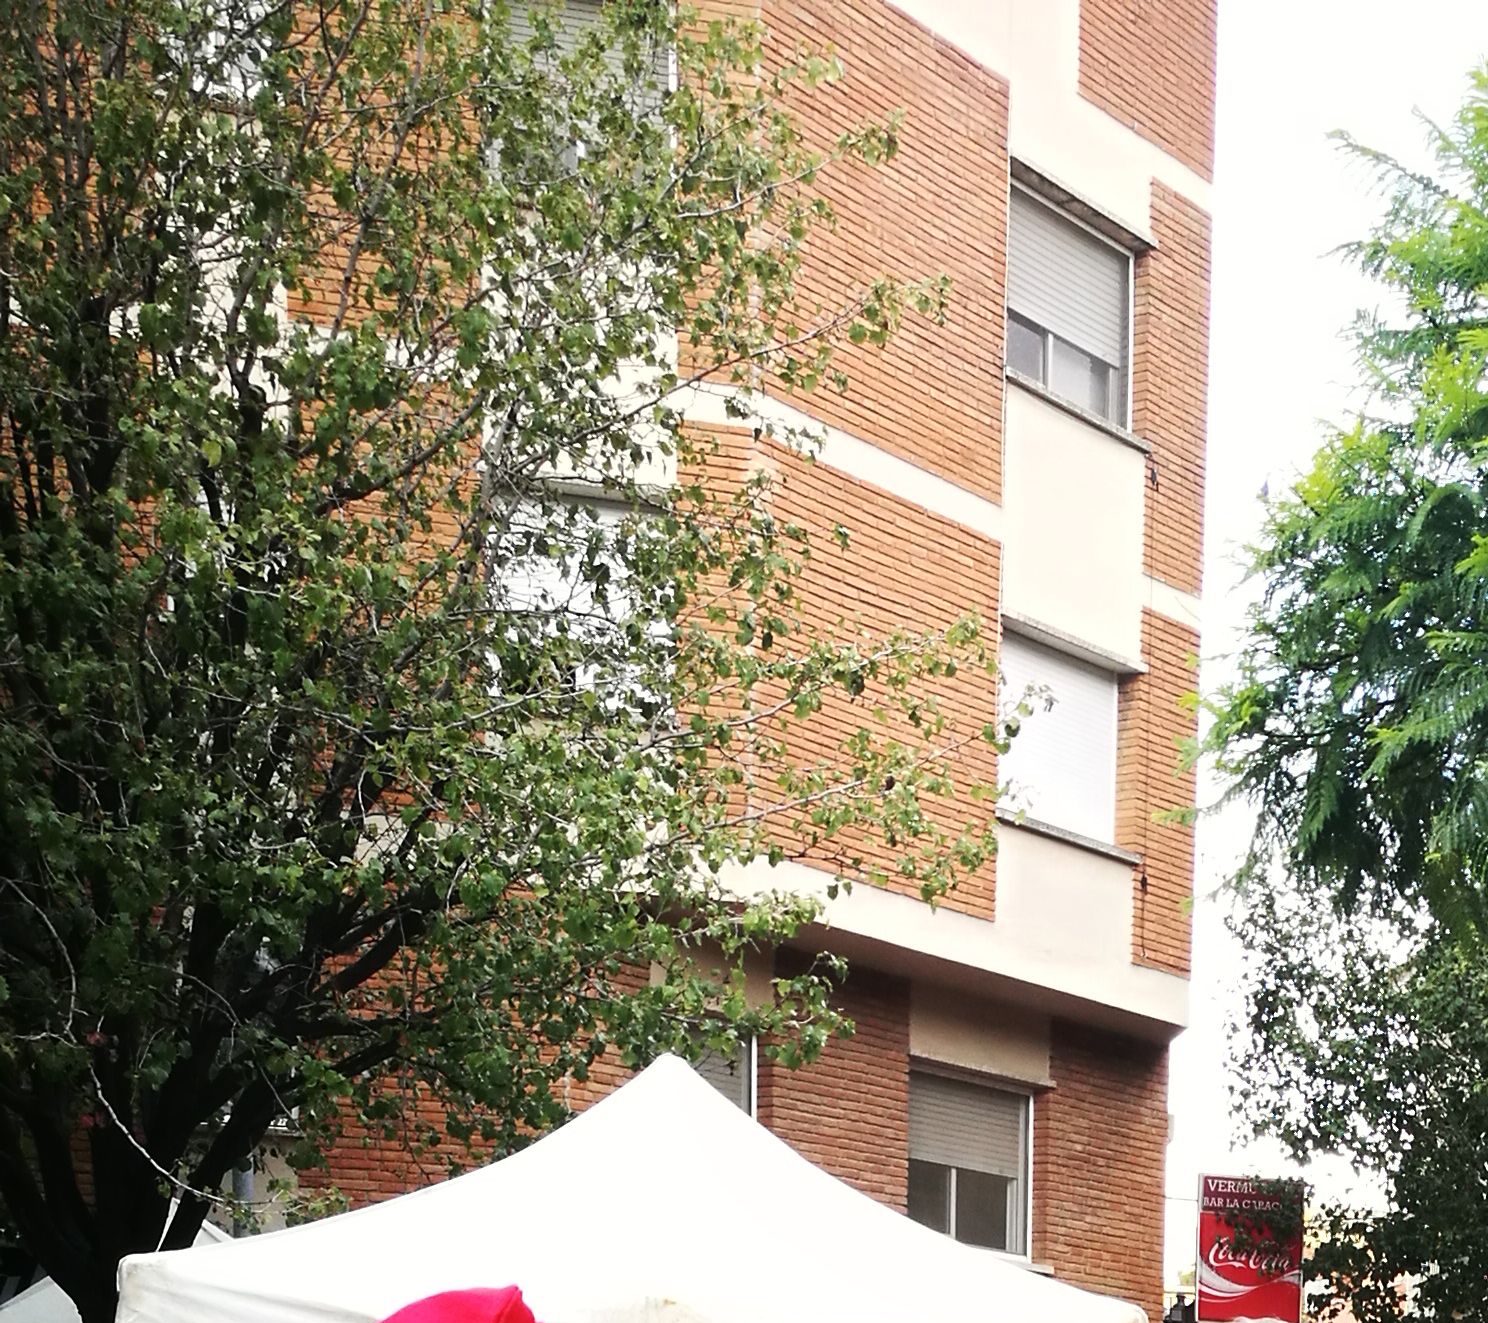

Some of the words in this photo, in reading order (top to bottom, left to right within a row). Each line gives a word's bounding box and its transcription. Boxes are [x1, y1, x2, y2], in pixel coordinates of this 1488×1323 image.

[1203, 1196, 1224, 1208] BAR
[1226, 1197, 1240, 1208] LA
[1209, 1236, 1290, 1271] CocaCola
